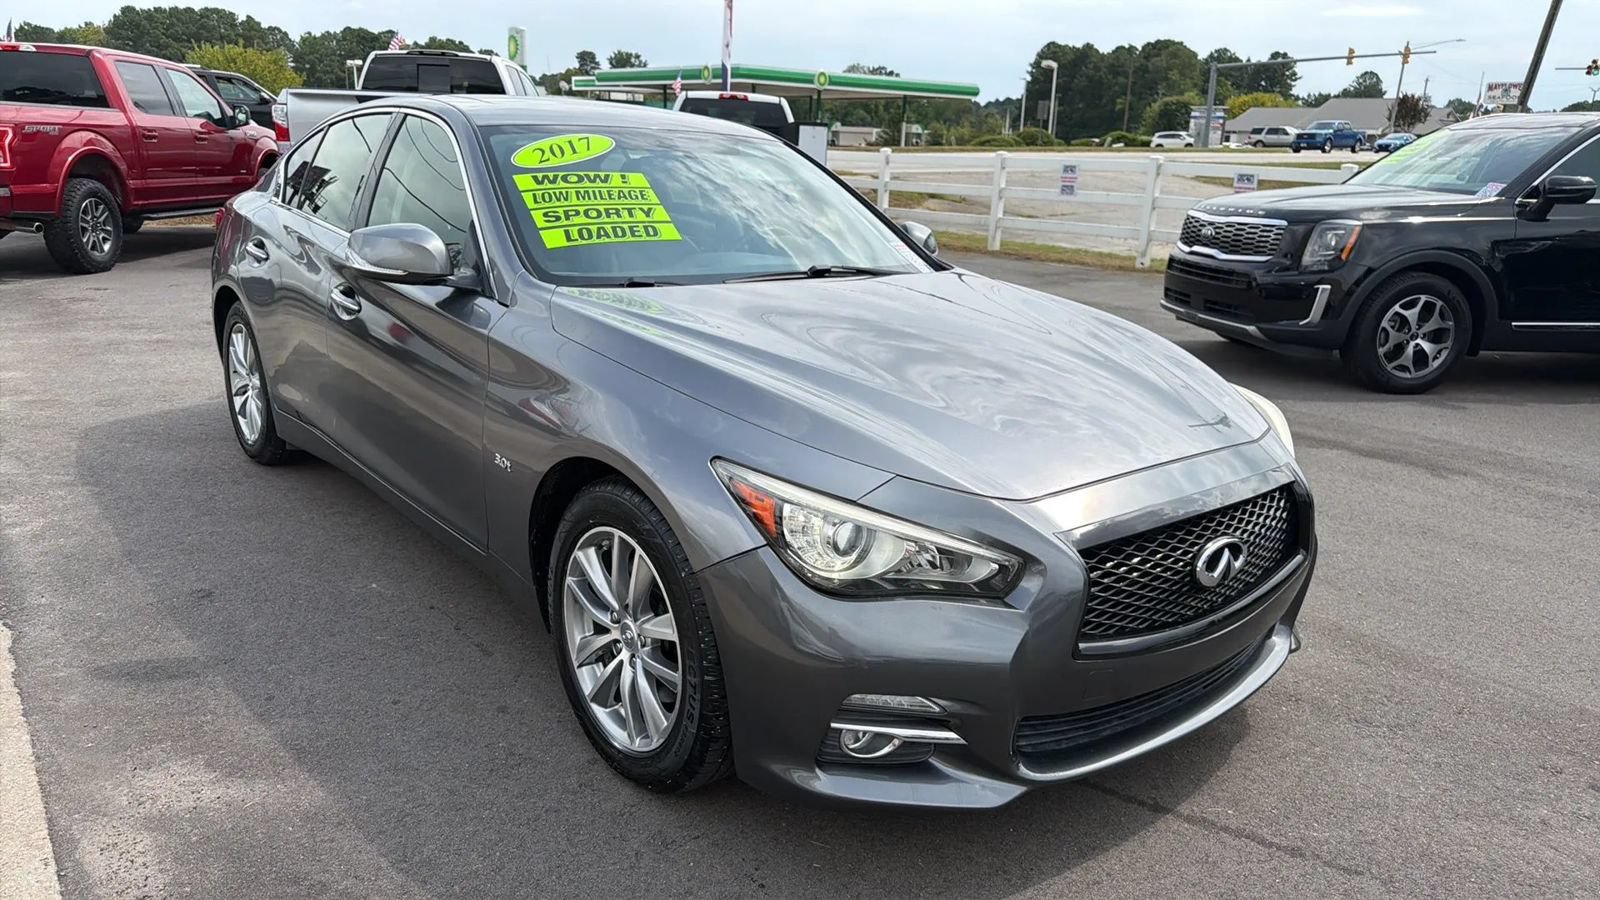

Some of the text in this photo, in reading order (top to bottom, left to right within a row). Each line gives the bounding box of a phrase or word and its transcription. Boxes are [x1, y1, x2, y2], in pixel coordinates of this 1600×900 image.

[1487, 82, 1523, 91] MAYFLOWE
[22, 125, 63, 133] SPORT
[532, 136, 592, 165] 2017
[533, 173, 613, 186] WOW
[532, 189, 651, 205] LOW MILEAGE
[543, 207, 656, 224] SPORTY
[564, 225, 660, 243] LOADED
